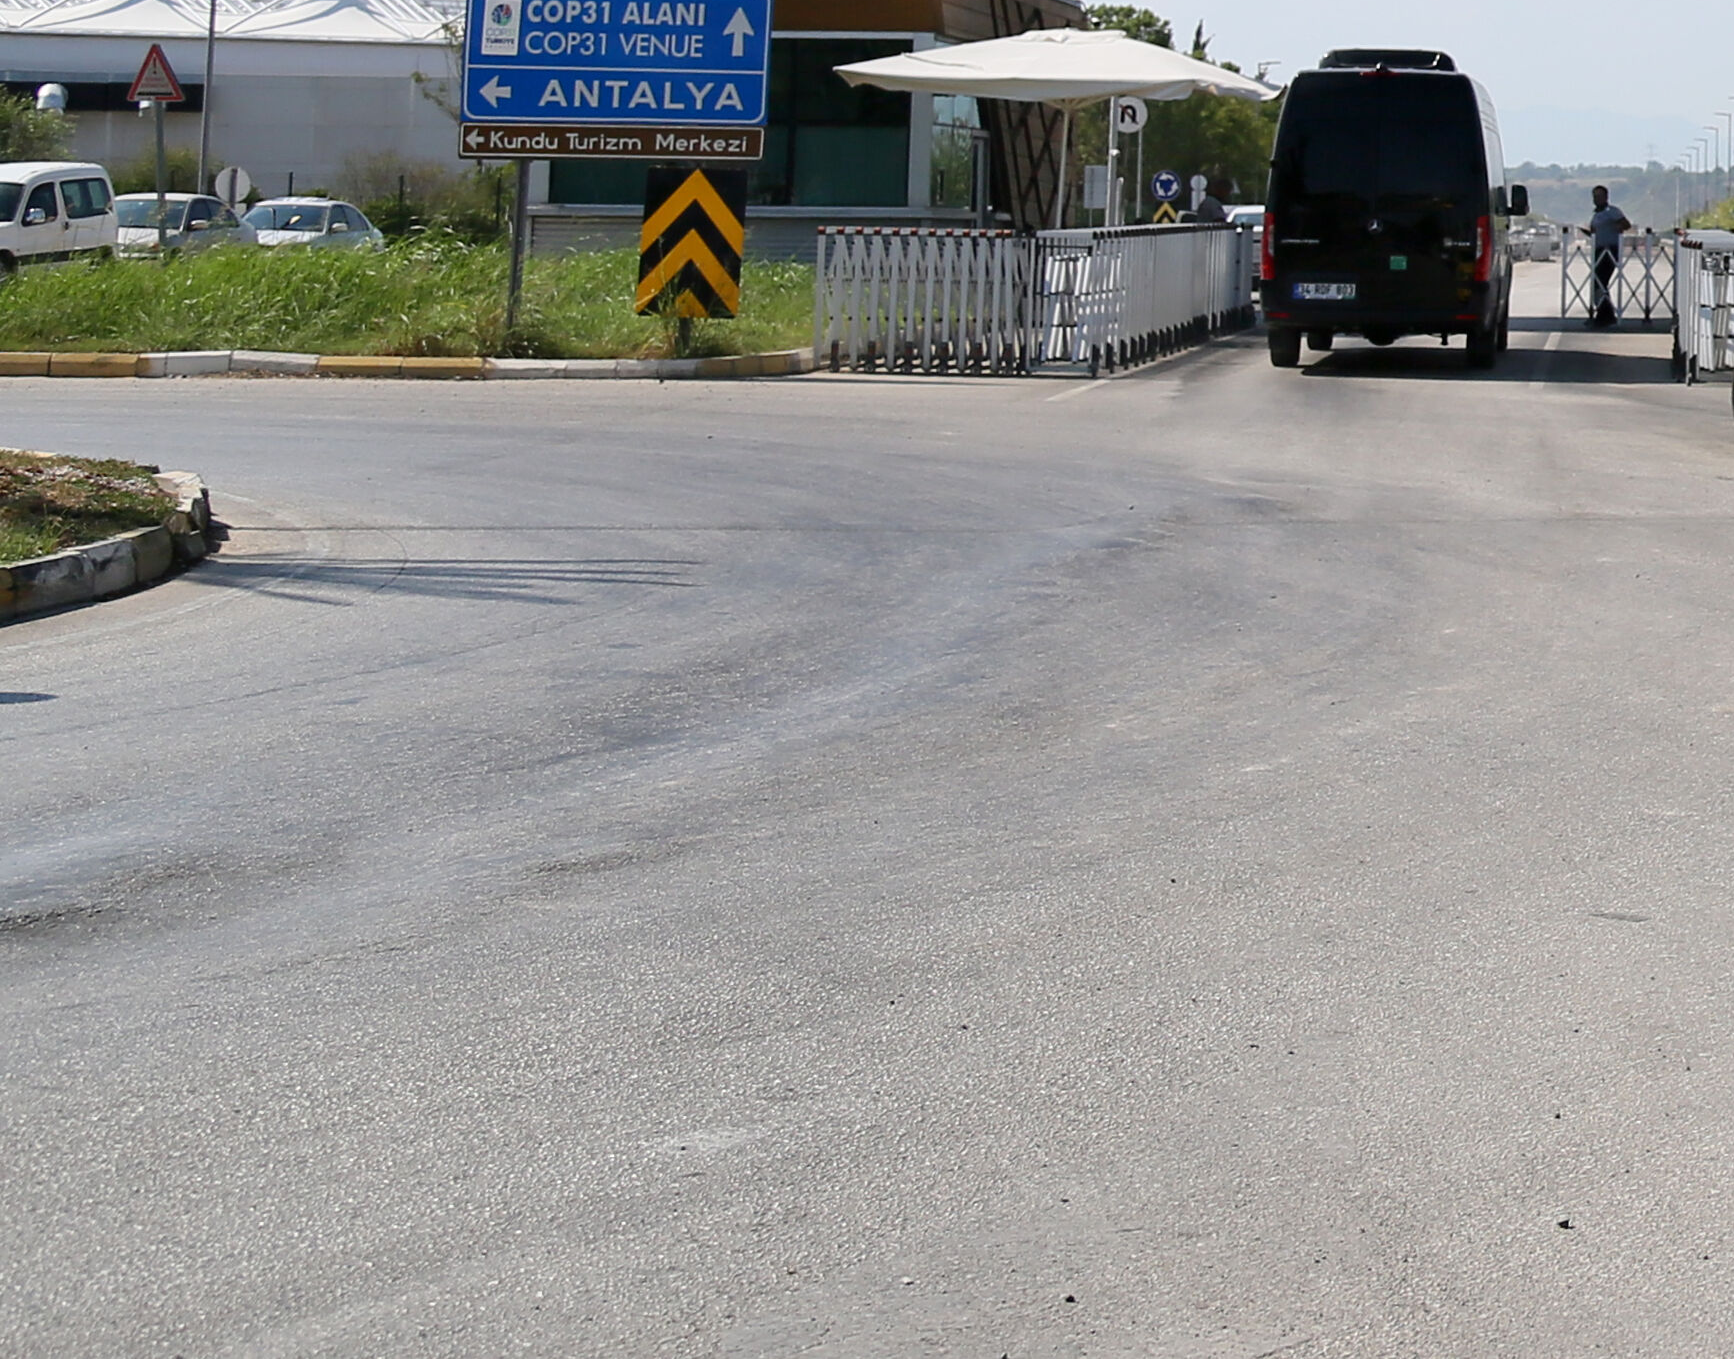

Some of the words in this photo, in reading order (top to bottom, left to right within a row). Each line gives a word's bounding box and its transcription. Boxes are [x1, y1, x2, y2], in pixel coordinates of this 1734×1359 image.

[527, 0, 610, 24] COP31
[622, 1, 706, 26] ALANI
[525, 31, 607, 55] COP31
[619, 33, 704, 57] VENUE
[538, 79, 744, 111] ANTALYA
[489, 130, 558, 150] Kundu
[566, 133, 641, 150] Turizm
[655, 133, 747, 152] Merkezi
